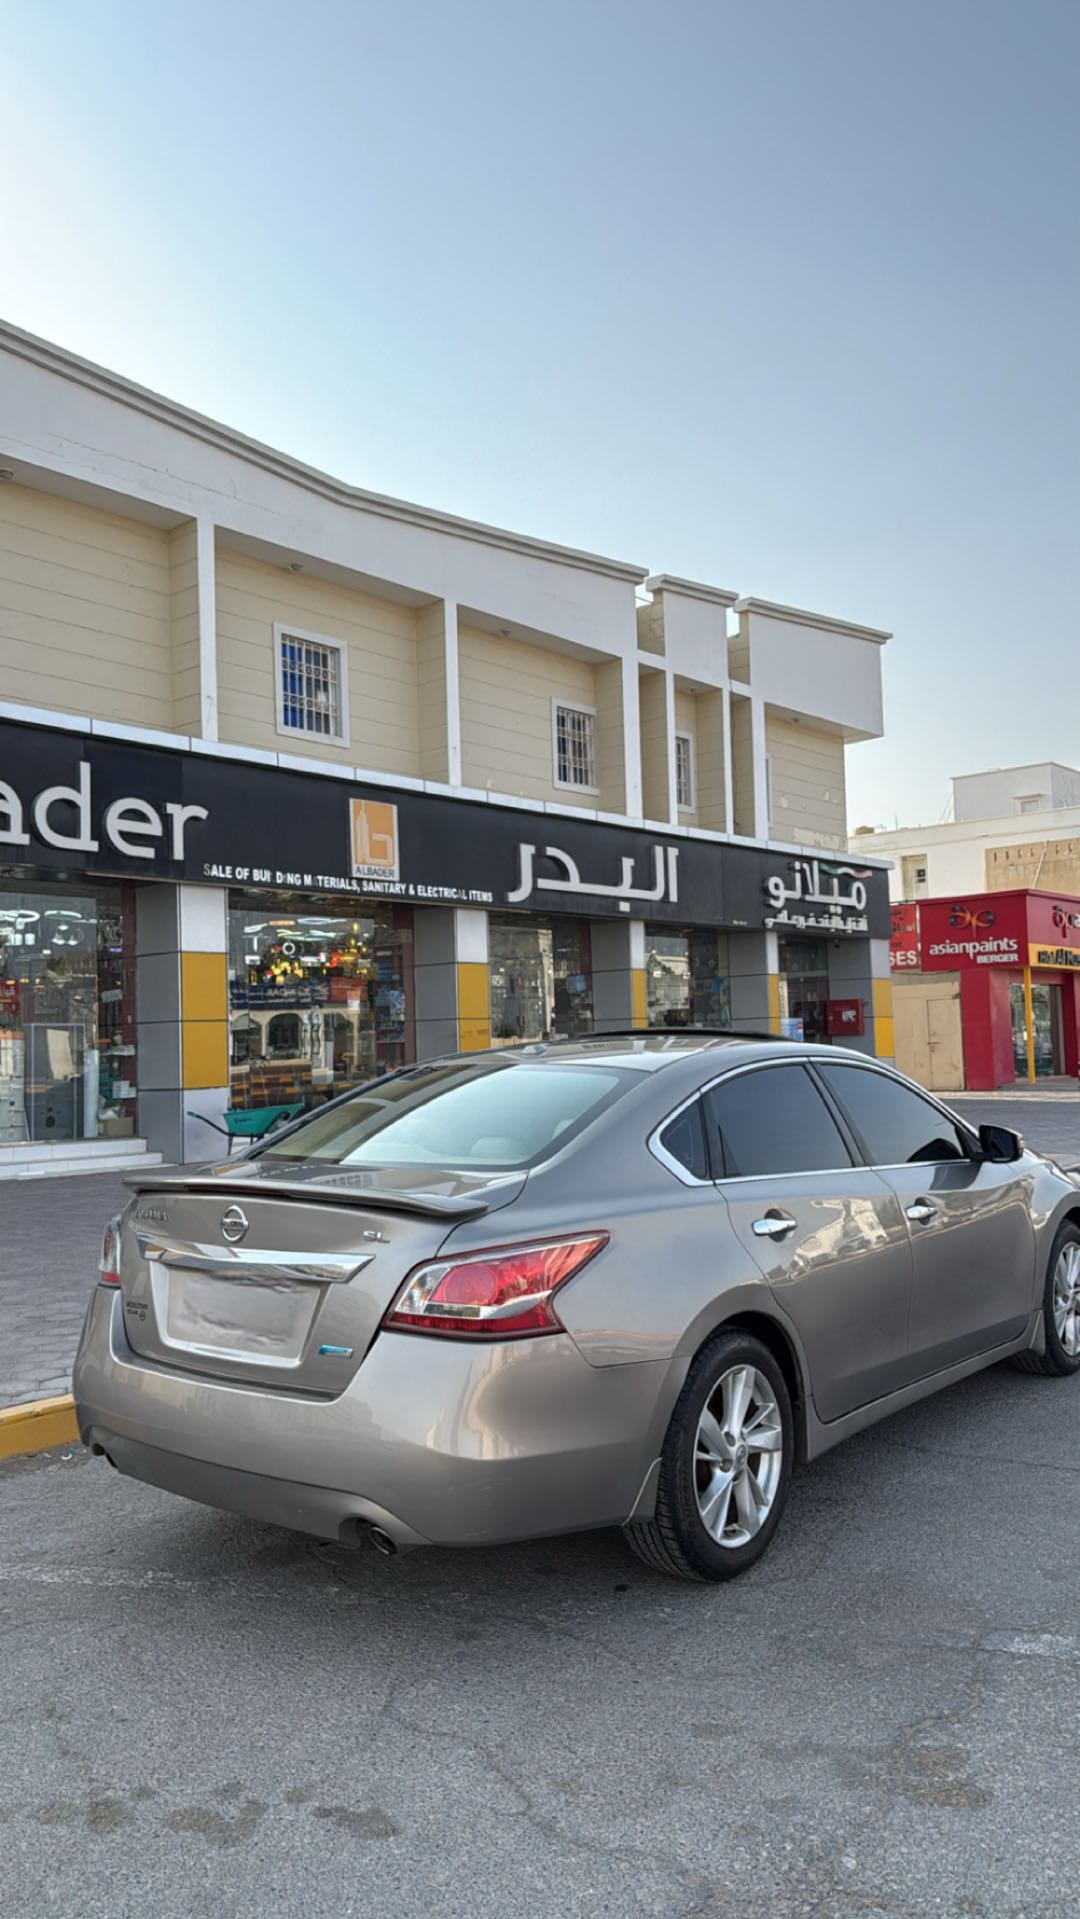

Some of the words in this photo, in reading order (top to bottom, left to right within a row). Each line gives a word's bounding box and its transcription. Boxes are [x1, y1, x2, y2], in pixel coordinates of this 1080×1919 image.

[203, 863, 233, 879] SALE
[235, 867, 250, 880] OF
[362, 880, 406, 895] SANITARY
[408, 883, 415, 896] &
[417, 885, 467, 900] ELECTRICAL
[469, 889, 493, 903] ITEMS
[355, 866, 395, 878] ALBADER
[508, 843, 679, 912] البدر
[768, 860, 867, 913] ميلانو
[929, 936, 1018, 961] asianpaints
[976, 953, 1018, 964] BERGER
